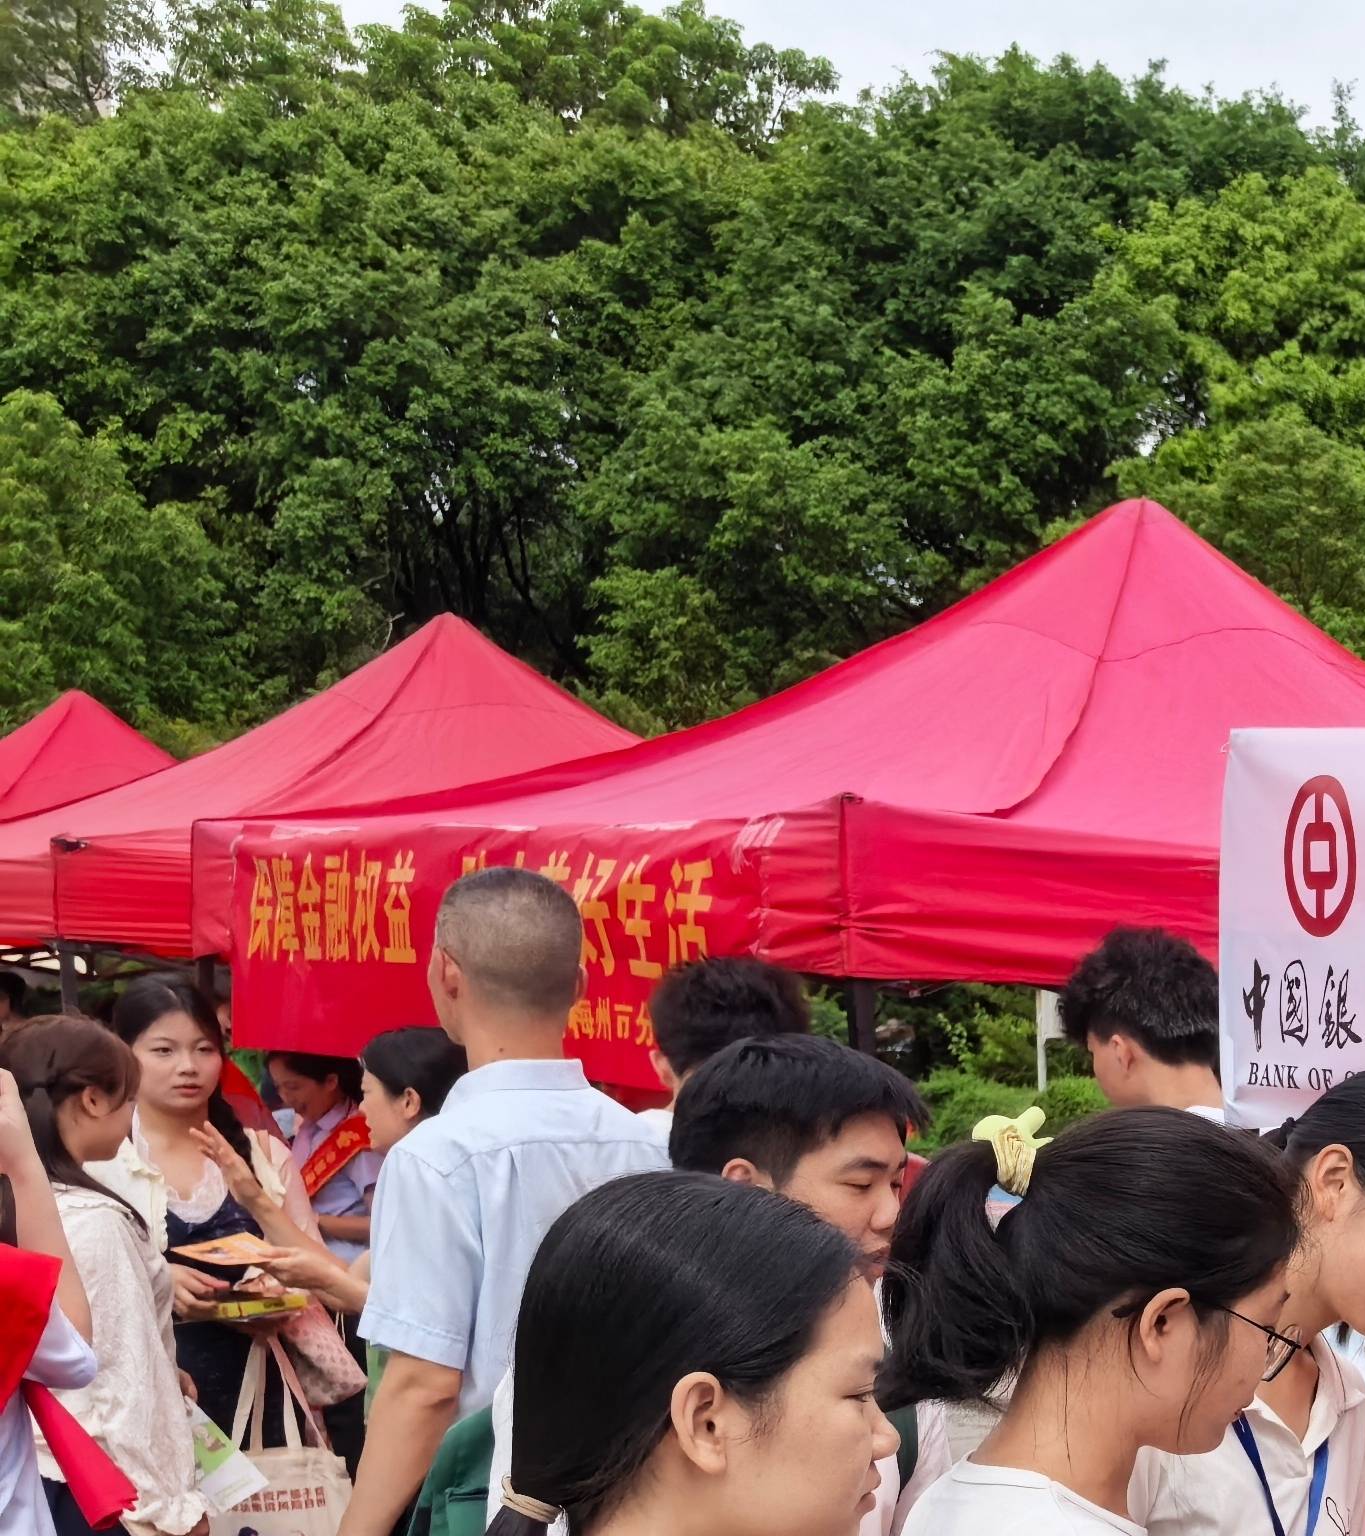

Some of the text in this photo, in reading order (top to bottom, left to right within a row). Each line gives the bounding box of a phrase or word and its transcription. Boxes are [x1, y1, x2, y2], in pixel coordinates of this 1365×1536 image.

[247, 849, 416, 964] 保障金融权益
[1248, 1062, 1300, 1090] BANK
[1308, 1067, 1333, 1092] OF
